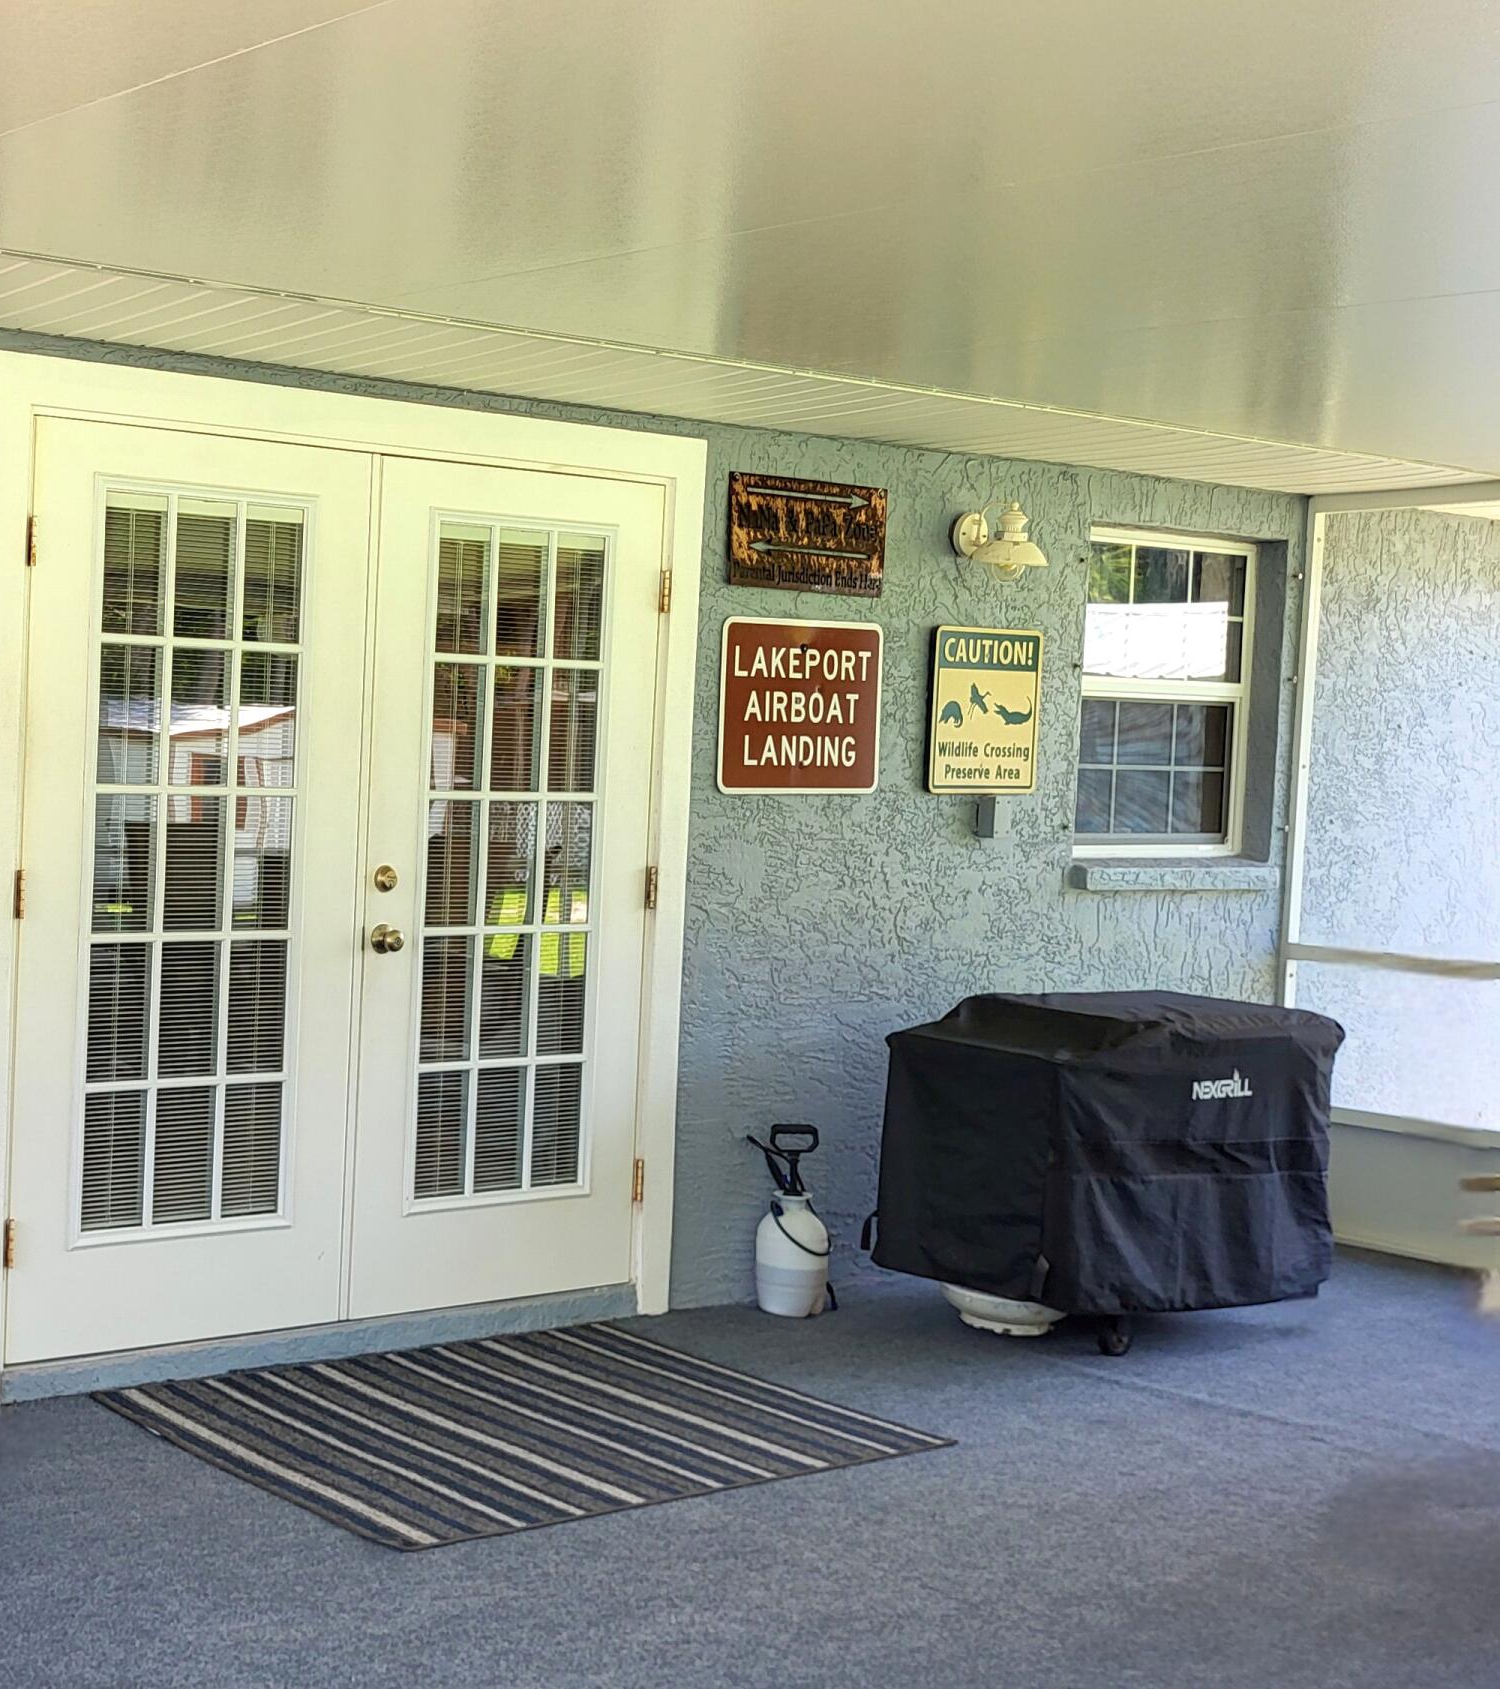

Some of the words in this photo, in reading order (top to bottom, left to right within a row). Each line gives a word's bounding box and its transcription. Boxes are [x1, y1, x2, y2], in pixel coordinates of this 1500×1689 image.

[777, 564, 832, 586] Jurisdiction
[835, 568, 858, 588] Ends
[734, 645, 871, 682] LAKEPORT
[944, 637, 1034, 667] CAUTION!
[744, 690, 859, 724] AIRBOAT
[744, 735, 856, 767] LANDING
[938, 741, 979, 757] Wildlife
[984, 742, 1030, 762] Crossing
[944, 764, 990, 780] Preserve
[995, 764, 1021, 780] Area
